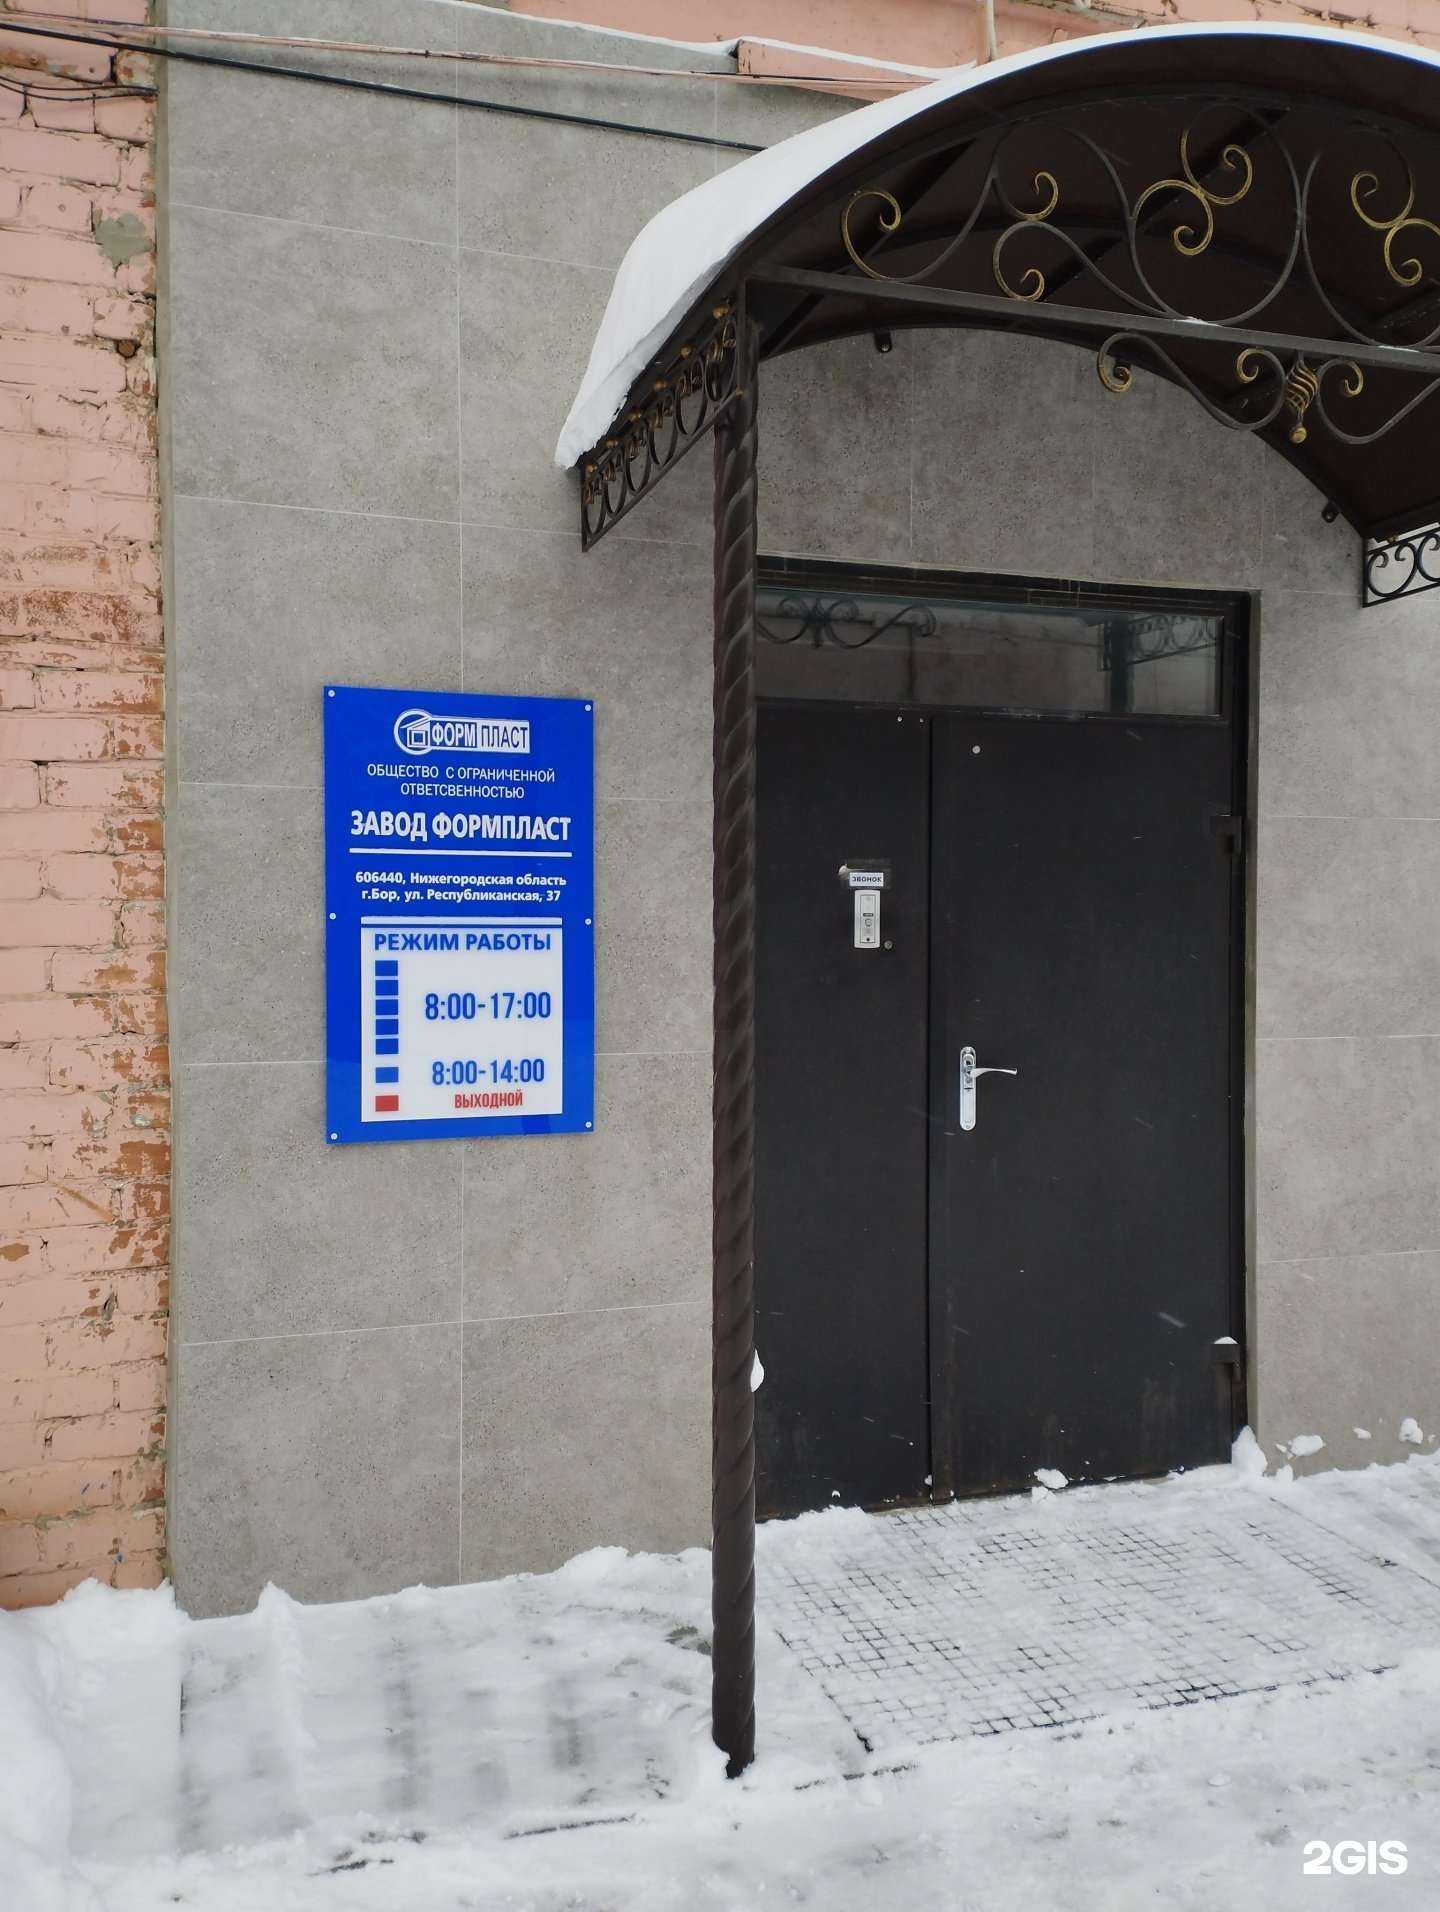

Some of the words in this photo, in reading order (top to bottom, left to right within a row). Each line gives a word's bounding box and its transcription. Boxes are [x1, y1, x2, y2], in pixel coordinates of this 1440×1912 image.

[367, 764, 439, 779] ОБЩЕСТВО
[446, 766, 455, 779] С
[457, 766, 555, 783] ОГРАНИЧЕННОЙ
[400, 783, 525, 799] ОТВЕТСВЕННОСТЬЮ
[351, 810, 428, 842] ЗАВОД
[432, 811, 571, 841] ФОРМПЛАСТ
[355, 871, 406, 886] 606440,
[410, 872, 513, 886] Нижегородская
[516, 873, 567, 886] область
[361, 888, 400, 903] г.Бор,
[405, 890, 423, 903] ул.
[427, 889, 542, 904] Республиканская,
[546, 890, 561, 901] 37
[374, 933, 459, 951] РЕЖИМ
[465, 933, 551, 951] РАБОТЫ
[425, 992, 551, 1020] 8:00-17:00
[432, 1058, 545, 1085] 8:00-14:00
[454, 1089, 523, 1109] ВЫХОДНОЙ
